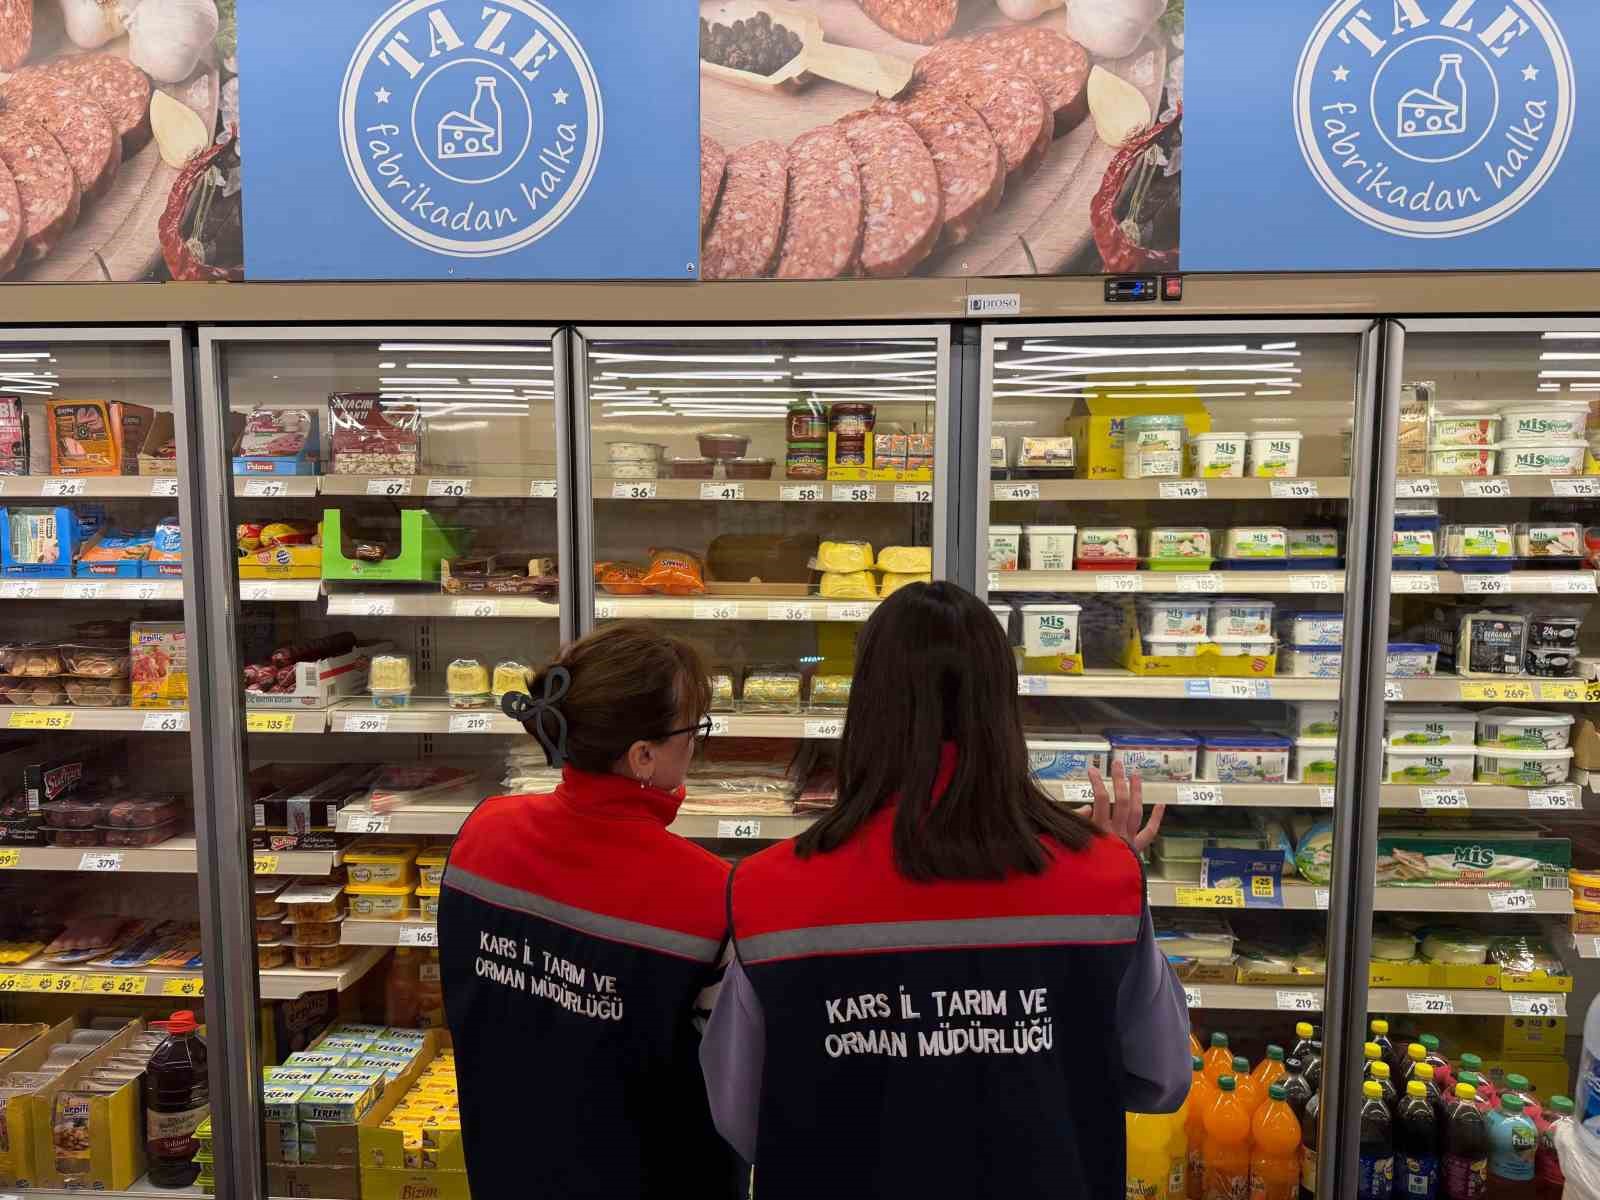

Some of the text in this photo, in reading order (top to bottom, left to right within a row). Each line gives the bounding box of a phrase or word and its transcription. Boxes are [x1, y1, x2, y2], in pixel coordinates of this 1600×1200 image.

[377, 6, 559, 81] TAZE
[1322, 99, 1548, 212] fabrikadan halka
[366, 123, 578, 232] fabrikadan halka
[59, 484, 76, 496] 24
[263, 486, 279, 497] 47
[386, 484, 403, 495] 67
[444, 485, 464, 496] 40
[631, 487, 648, 497] 36
[721, 488, 736, 499] 41
[1012, 489, 1031, 497] 419
[1178, 487, 1199, 496] 149
[1291, 486, 1310, 495] 139
[1410, 485, 1430, 494] 149
[1479, 485, 1501, 494] 100
[1573, 484, 1592, 493] 125
[798, 489, 816, 500] 58
[851, 489, 868, 500] 58
[1479, 581, 1501, 591] 269
[474, 606, 492, 617] 69
[786, 608, 803, 620] 36
[1040, 615, 1064, 627] MİS
[1231, 685, 1248, 695] 119
[1504, 689, 1525, 698] 269
[46, 717, 61, 726] 155
[160, 719, 178, 730] 63
[266, 719, 283, 729] 135
[359, 720, 379, 730] 299
[467, 719, 485, 729] 219
[818, 724, 837, 735] 469
[1192, 791, 1214, 801] 309
[1436, 795, 1458, 805] 205
[1547, 795, 1567, 806] 195
[366, 821, 382, 832] 57
[734, 825, 752, 837] 64
[1453, 844, 1494, 864] MİS
[97, 859, 115, 868] 379
[1214, 895, 1233, 905] 225
[1507, 895, 1526, 905] 479
[417, 932, 432, 943] 165
[480, 931, 617, 994] KARS İL TARIM VE
[56, 979, 71, 991] 39
[118, 981, 134, 993] 42
[475, 957, 624, 1021] ORMAN MÜDÜRLÜĞÜ
[825, 984, 1048, 1024] KARS İL TARIM VE
[1295, 999, 1312, 1008] 219
[1425, 1000, 1444, 1010] 227
[1529, 1002, 1548, 1015] 49
[824, 1016, 1053, 1058] ORMAN MÜDÜRLÜĞÜ
[272, 1072, 313, 1080] TEREM
[331, 1072, 371, 1081] TEREM
[313, 1090, 354, 1098] TEREM
[312, 1109, 341, 1118] TEREM
